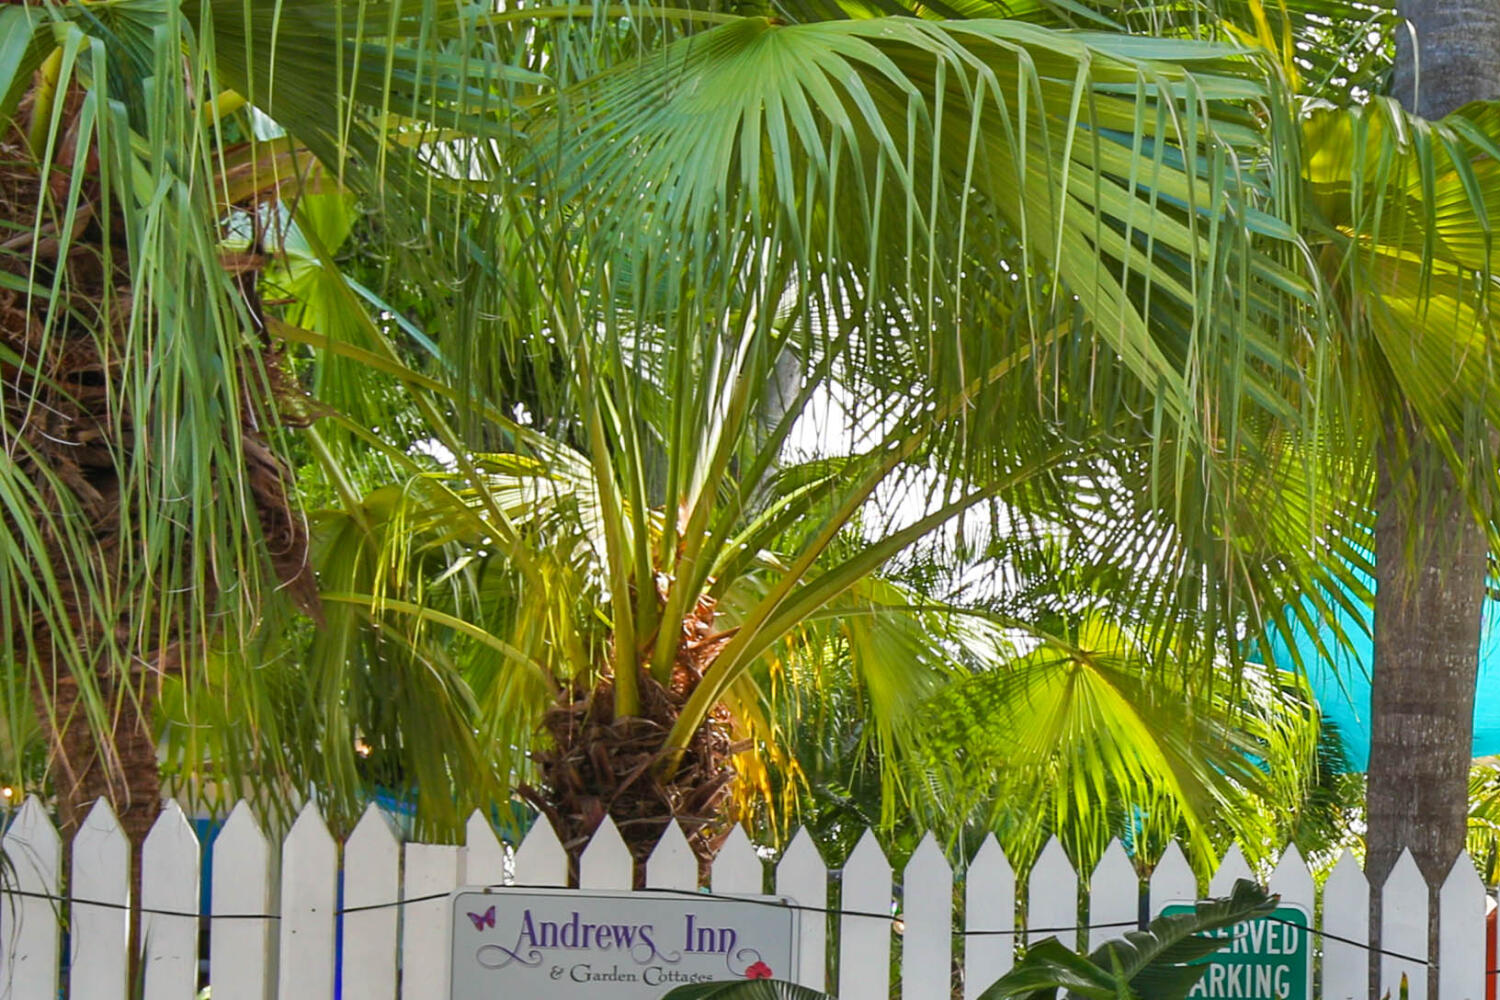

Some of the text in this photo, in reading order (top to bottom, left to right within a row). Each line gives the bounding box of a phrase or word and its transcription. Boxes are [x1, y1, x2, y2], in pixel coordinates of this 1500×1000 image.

[477, 909, 762, 976] Andrews Inn
[550, 964, 713, 986] & Garden Cottages
[1189, 963, 1290, 999] ARKING
